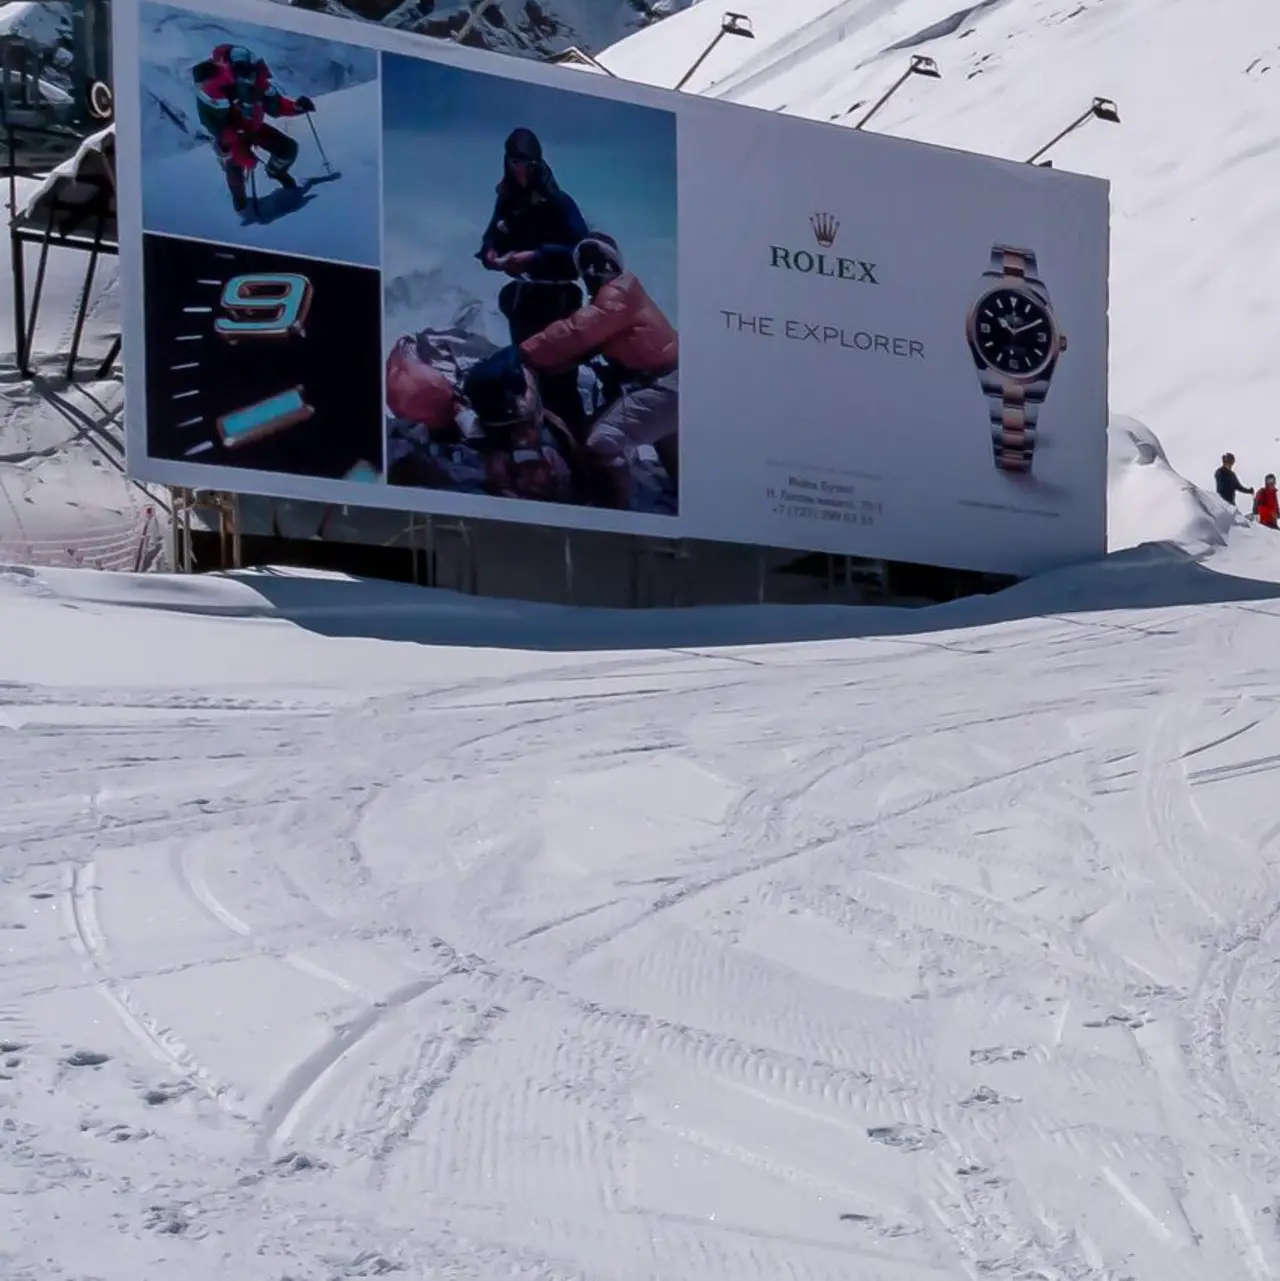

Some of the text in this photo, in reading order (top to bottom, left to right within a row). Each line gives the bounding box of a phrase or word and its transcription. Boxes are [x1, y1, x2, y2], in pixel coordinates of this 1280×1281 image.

[769, 245, 880, 285] ROLEX
[213, 271, 315, 344] 9
[719, 309, 925, 360] THE EXPLORER
